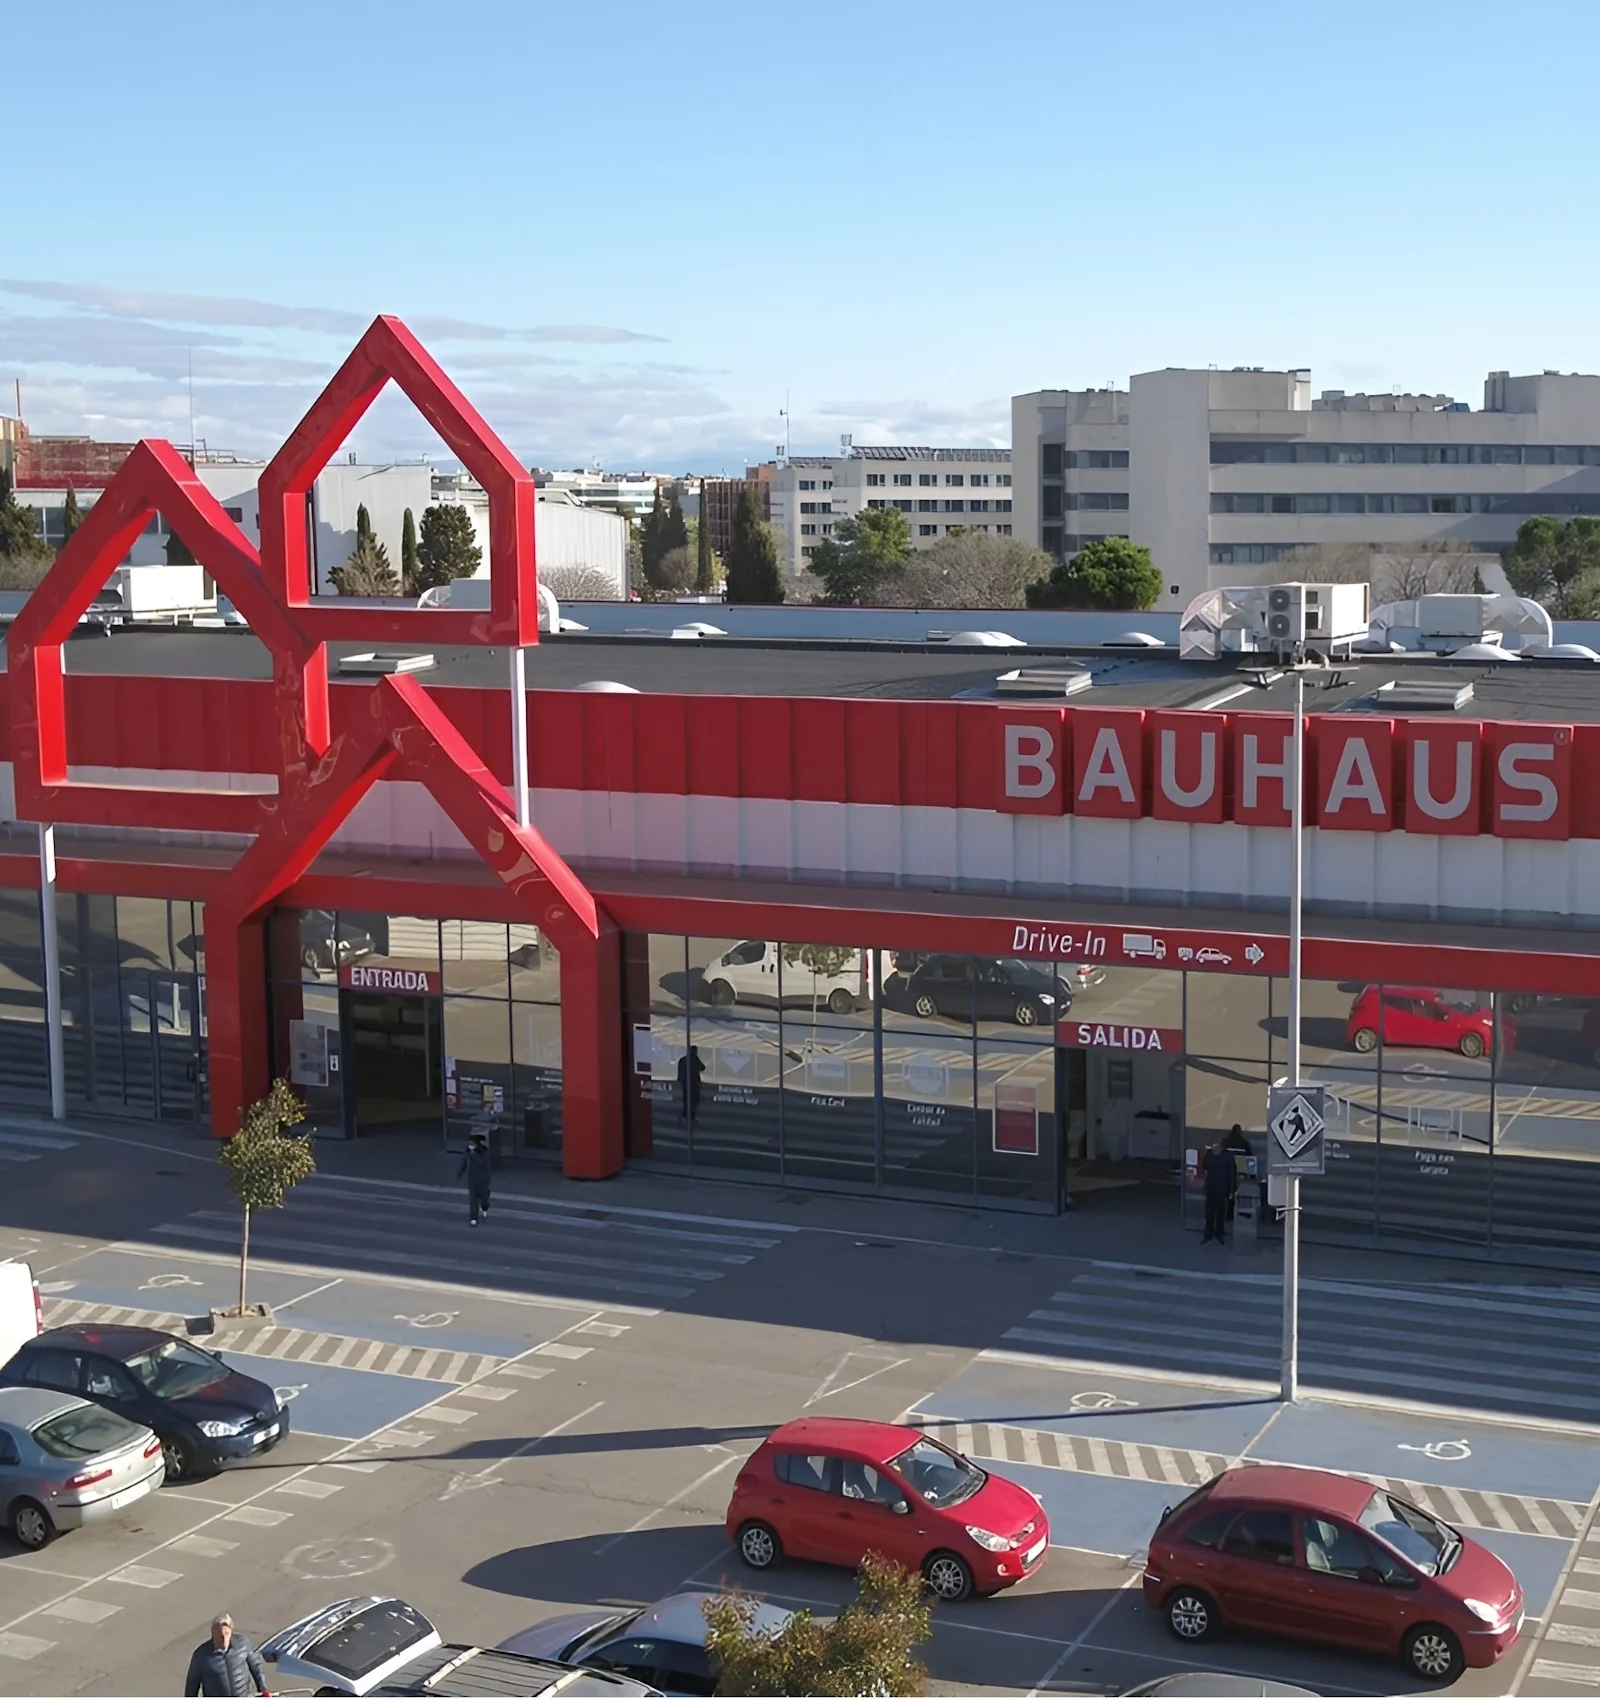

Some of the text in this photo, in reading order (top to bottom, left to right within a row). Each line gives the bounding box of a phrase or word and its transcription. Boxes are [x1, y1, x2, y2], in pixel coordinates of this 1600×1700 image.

[1003, 724, 1559, 822] BAUHAUS
[1012, 925, 1107, 956] Drive-In
[351, 965, 429, 992] ENTRADA
[1077, 1024, 1162, 1050] SALIDA
